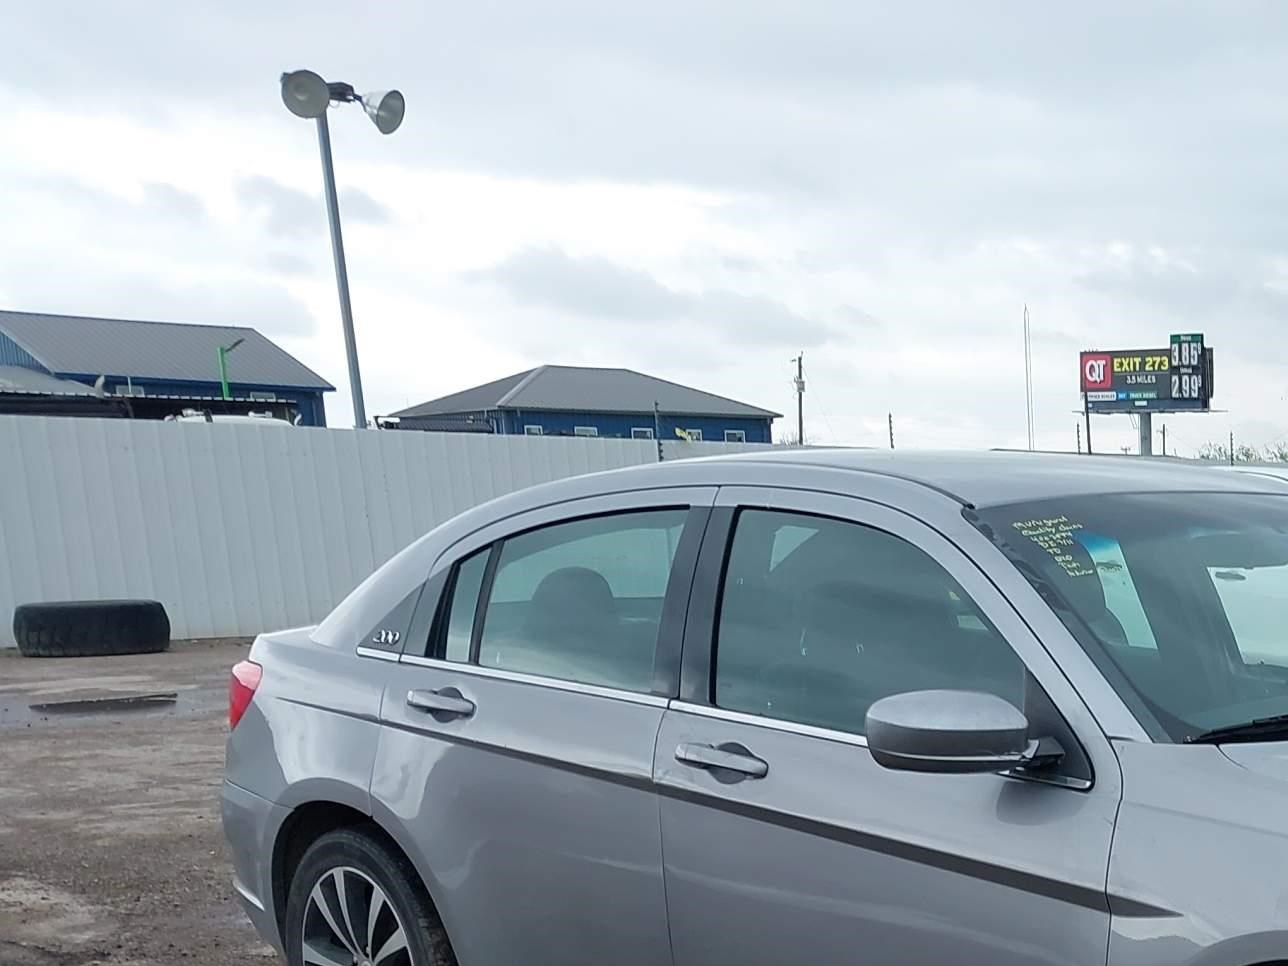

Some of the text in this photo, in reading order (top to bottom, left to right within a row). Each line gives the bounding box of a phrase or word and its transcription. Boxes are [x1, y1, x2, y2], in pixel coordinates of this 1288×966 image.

[1085, 359, 1106, 384] QT
[1113, 356, 1169, 372] EXIT 273
